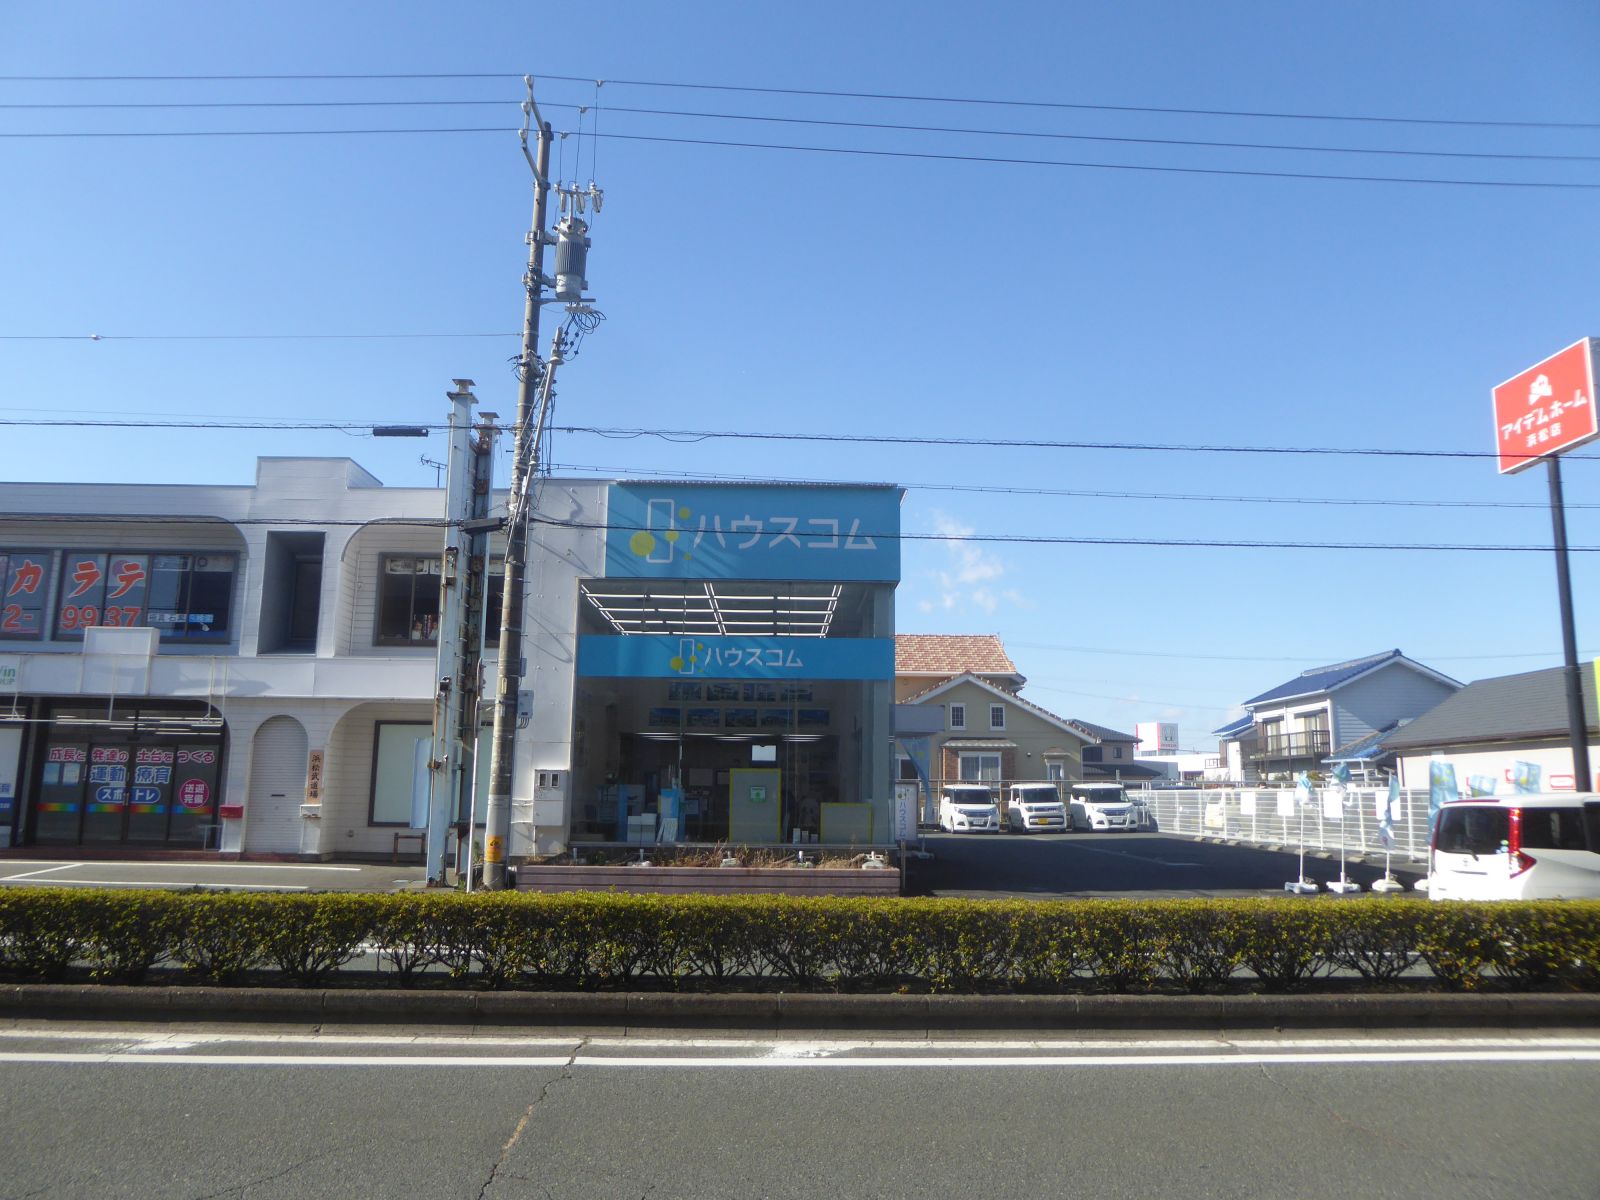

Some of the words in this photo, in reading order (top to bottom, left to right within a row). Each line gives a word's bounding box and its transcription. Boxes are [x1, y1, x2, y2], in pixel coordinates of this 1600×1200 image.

[693, 514, 878, 550] ハウスコム
[7, 559, 146, 599] カラテ
[704, 646, 804, 668] ハウスコム
[89, 765, 173, 784] 運動療育
[309, 754, 321, 799] 浜松武道場
